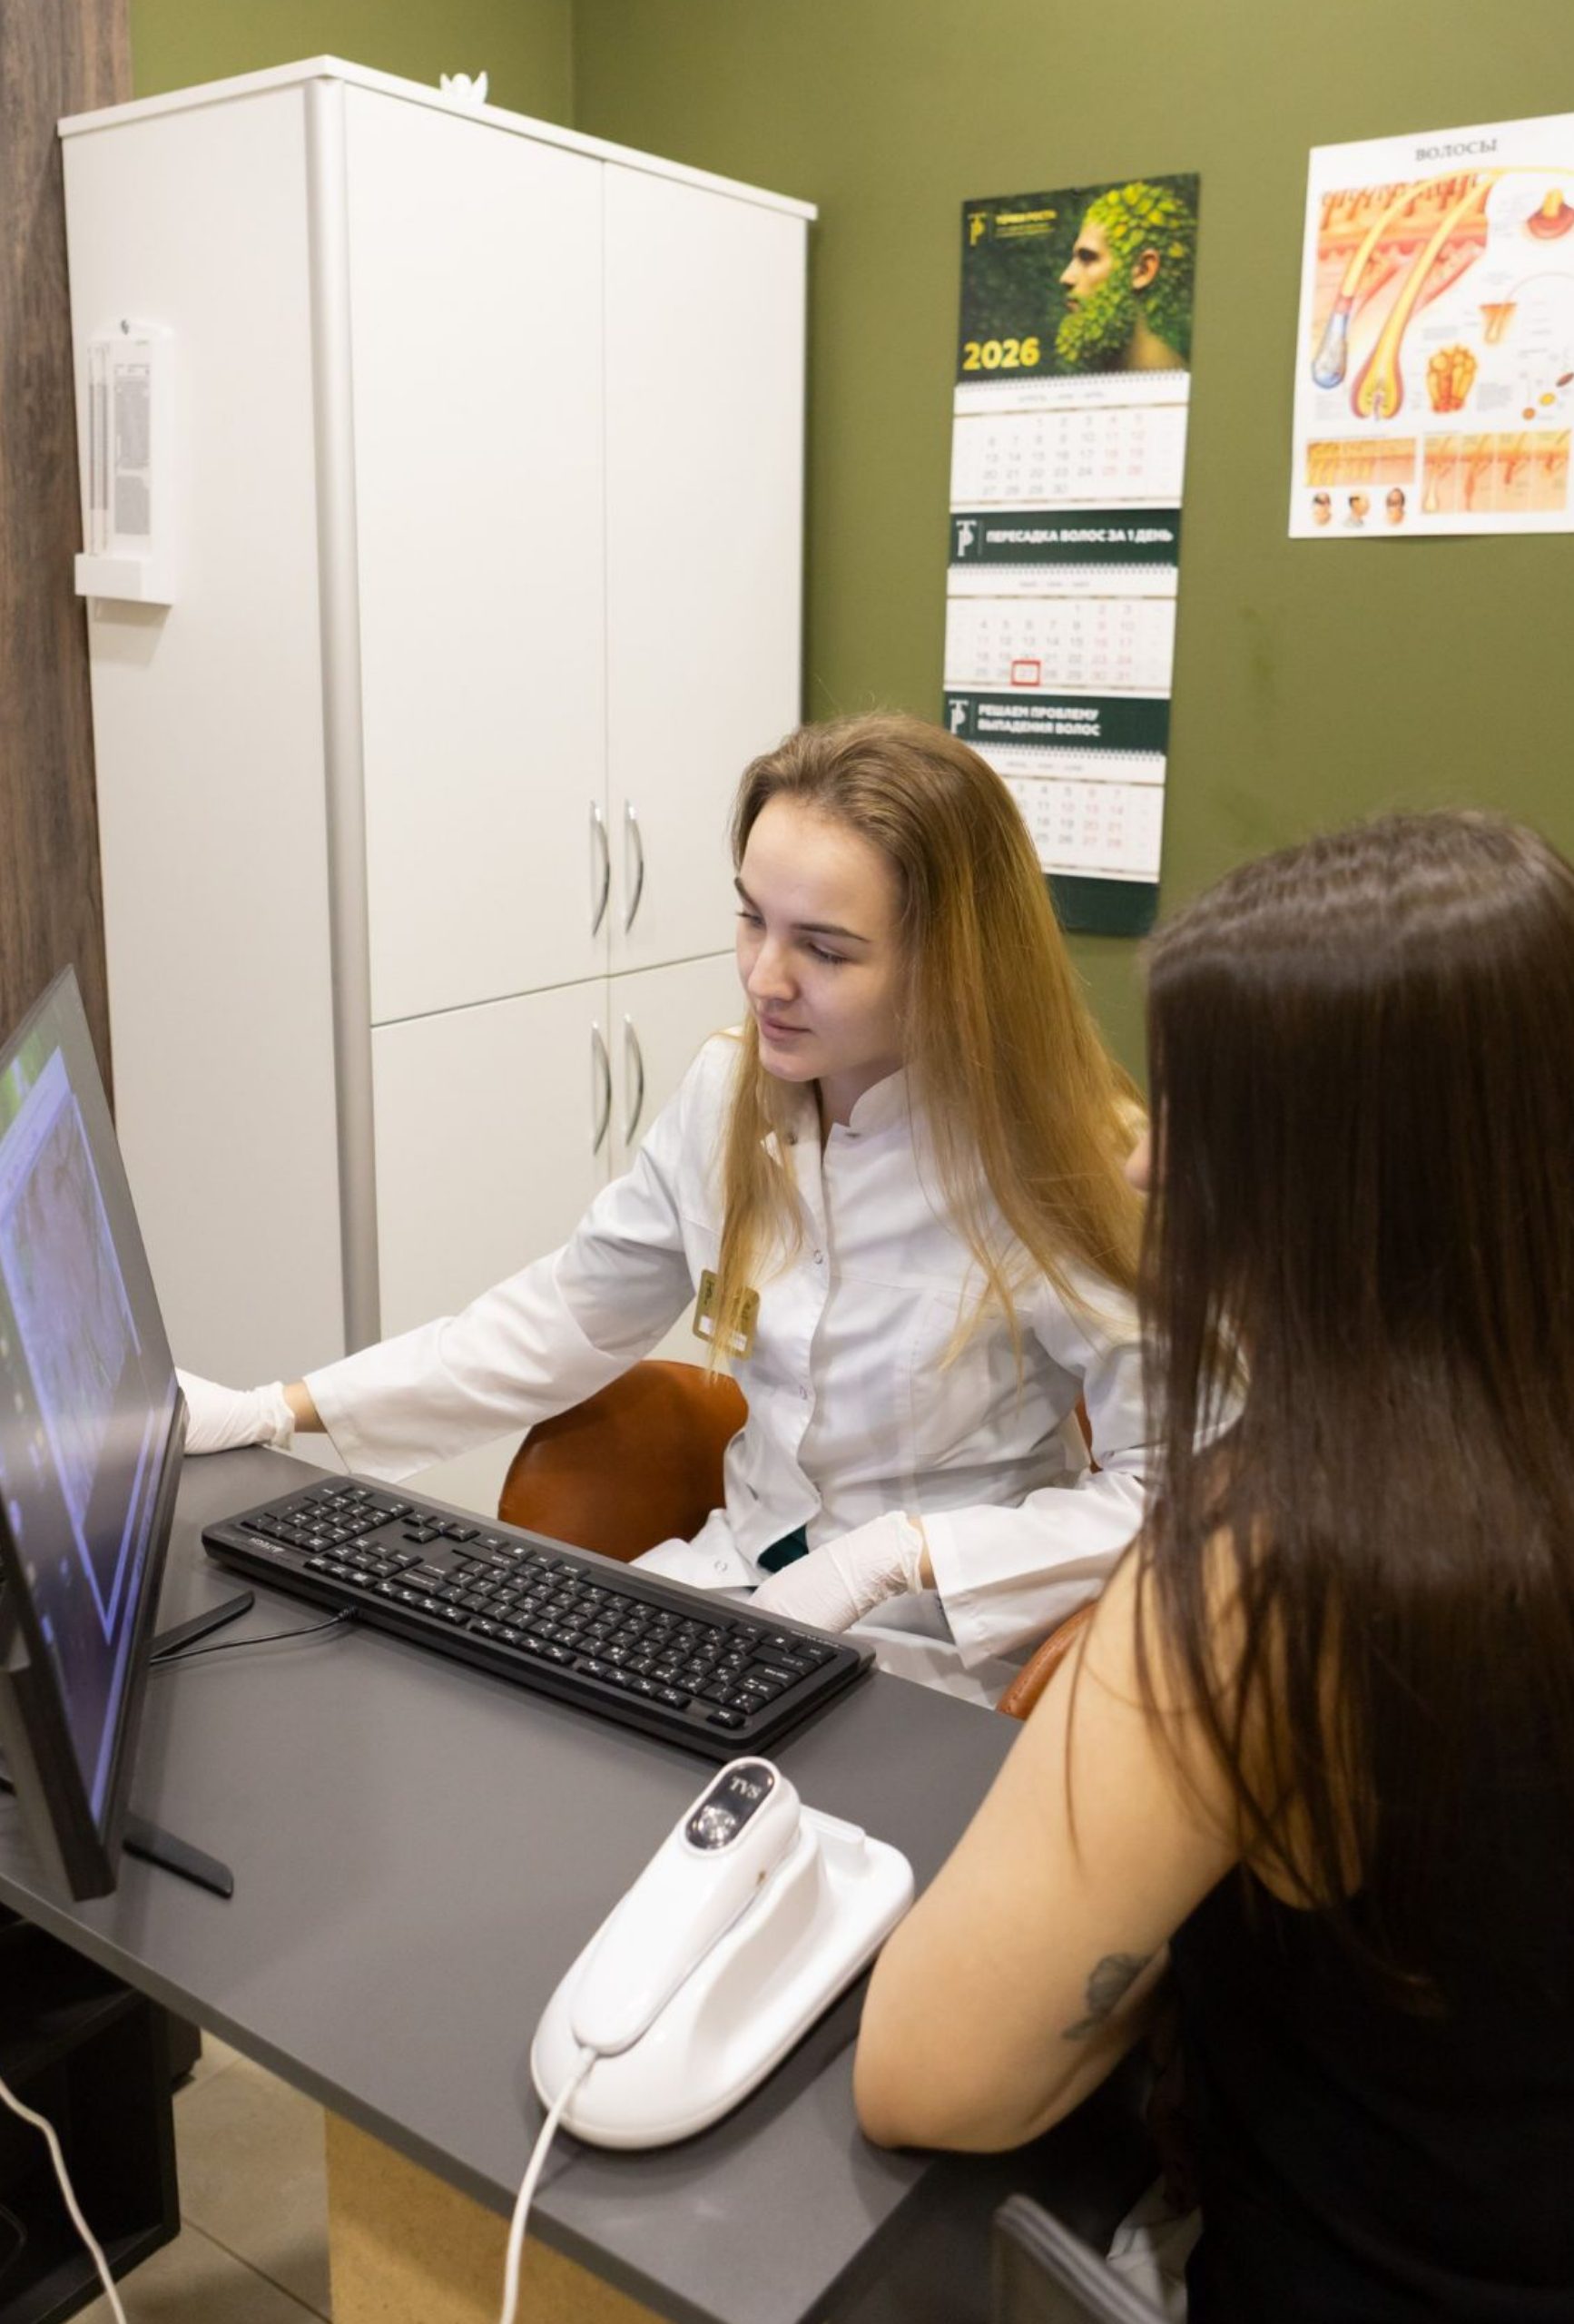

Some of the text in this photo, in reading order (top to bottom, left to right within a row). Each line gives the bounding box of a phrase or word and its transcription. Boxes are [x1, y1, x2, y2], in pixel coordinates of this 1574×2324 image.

[1415, 138, 1499, 162] ВОЛОСЫ
[962, 338, 1040, 369] 2026
[986, 529, 1058, 544] ПЕРЕСАДКА
[1060, 529, 1105, 543] ВОЛОС
[1108, 529, 1126, 542] ЗА
[1135, 528, 1174, 544] ДЕНЬ
[978, 704, 1099, 722] РЕШАЕМ ПРОБЛЕМУ
[977, 718, 1101, 737] ВЫПАДЕНИЯ ВОЛОС
